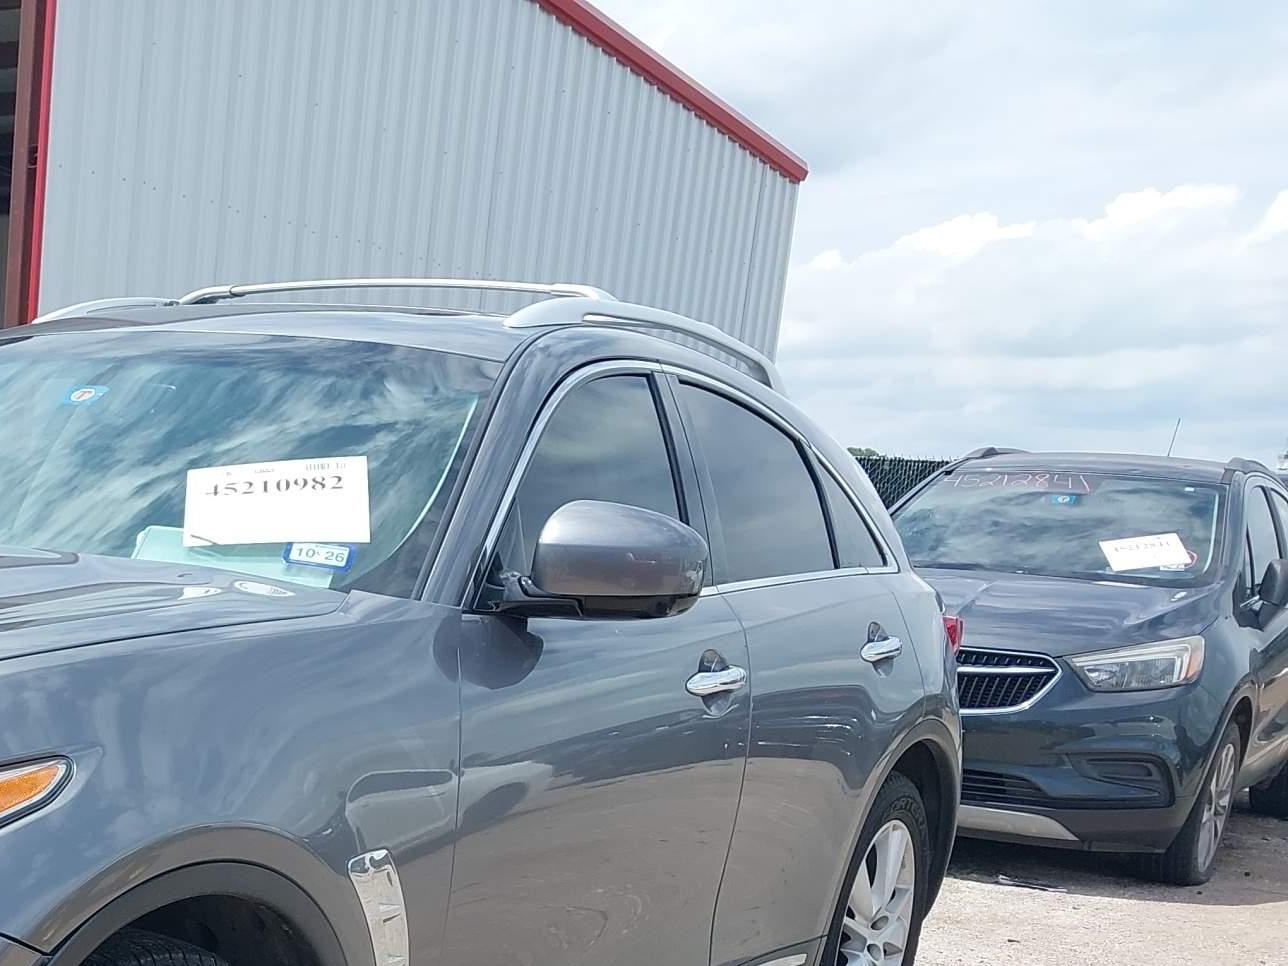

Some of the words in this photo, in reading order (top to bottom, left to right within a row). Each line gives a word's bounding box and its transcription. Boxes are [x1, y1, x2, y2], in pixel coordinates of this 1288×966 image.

[205, 475, 344, 497] 45210982
[943, 473, 1090, 492] 45212841
[324, 550, 345, 563] 26
